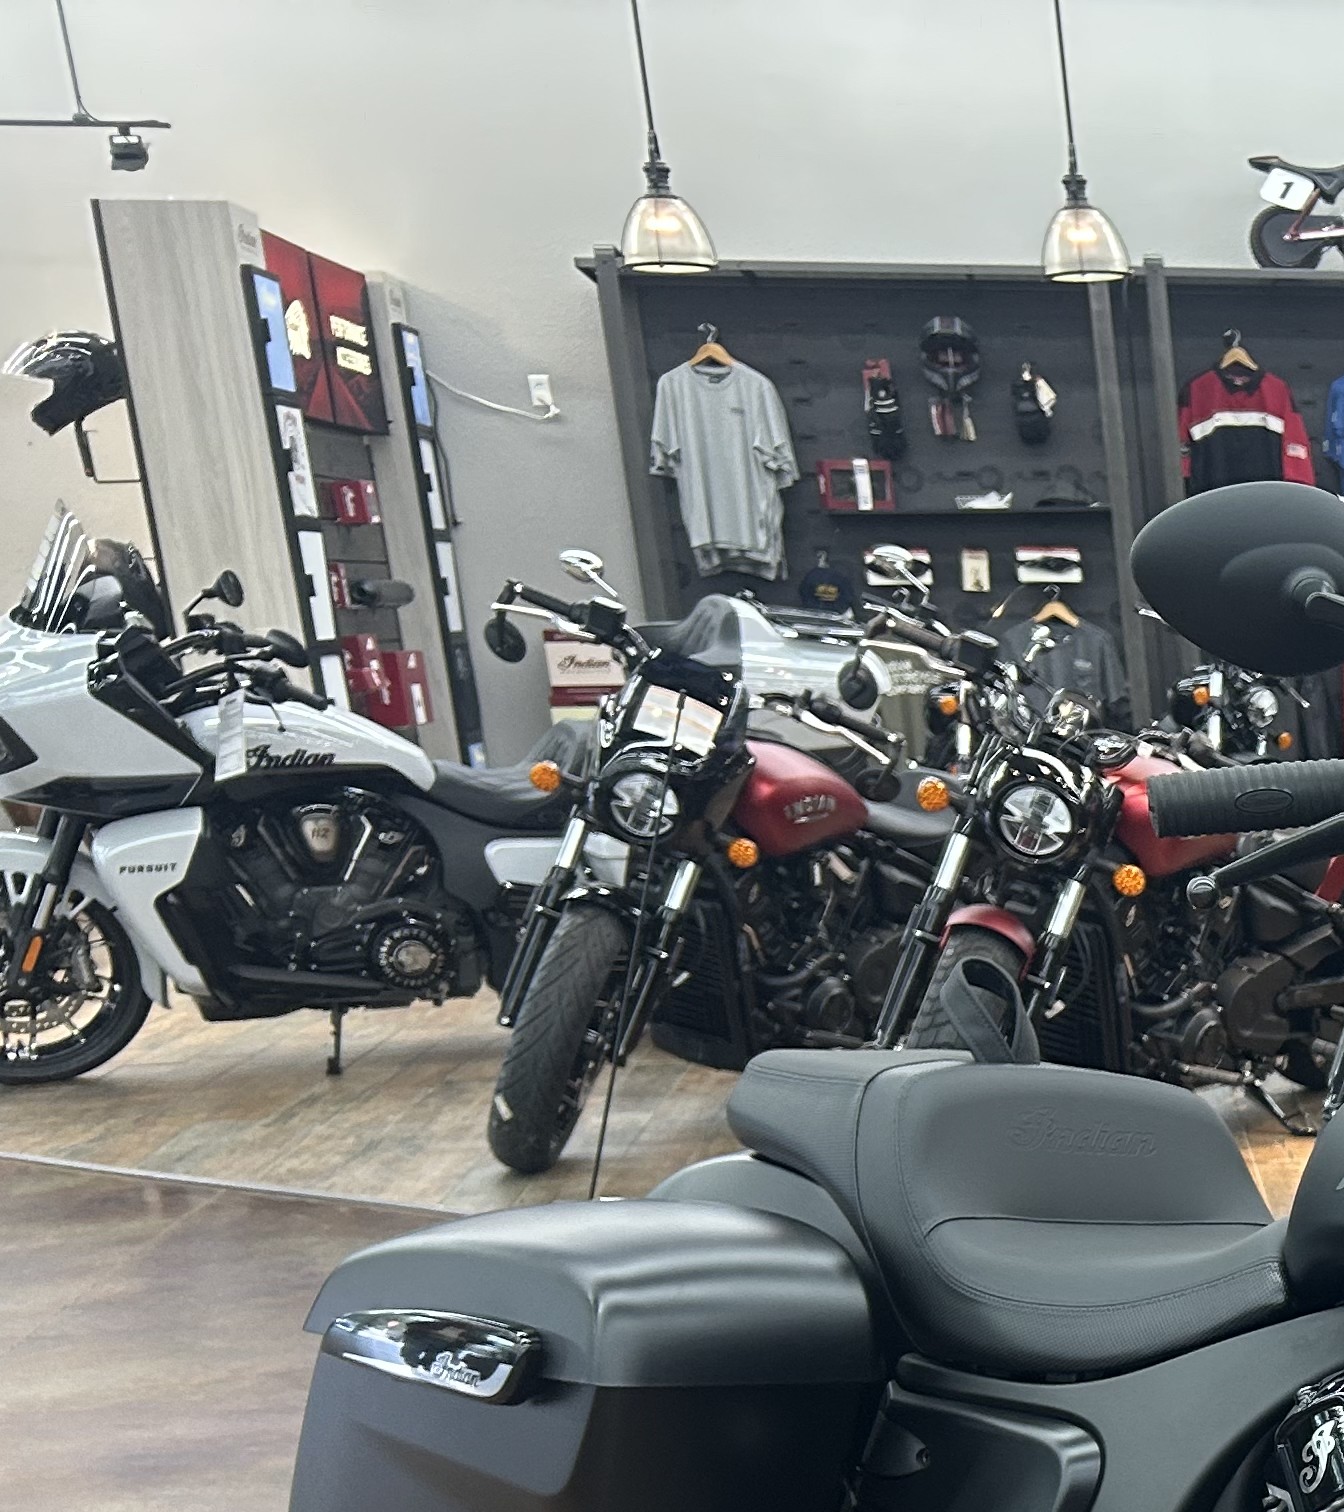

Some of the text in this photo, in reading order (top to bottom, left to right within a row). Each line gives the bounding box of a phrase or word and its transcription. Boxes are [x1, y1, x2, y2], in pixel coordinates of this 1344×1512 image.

[1278, 181, 1294, 199] 1
[246, 744, 336, 769] Indian
[119, 862, 177, 875] PURSUIT
[1007, 1106, 1157, 1159] Indian
